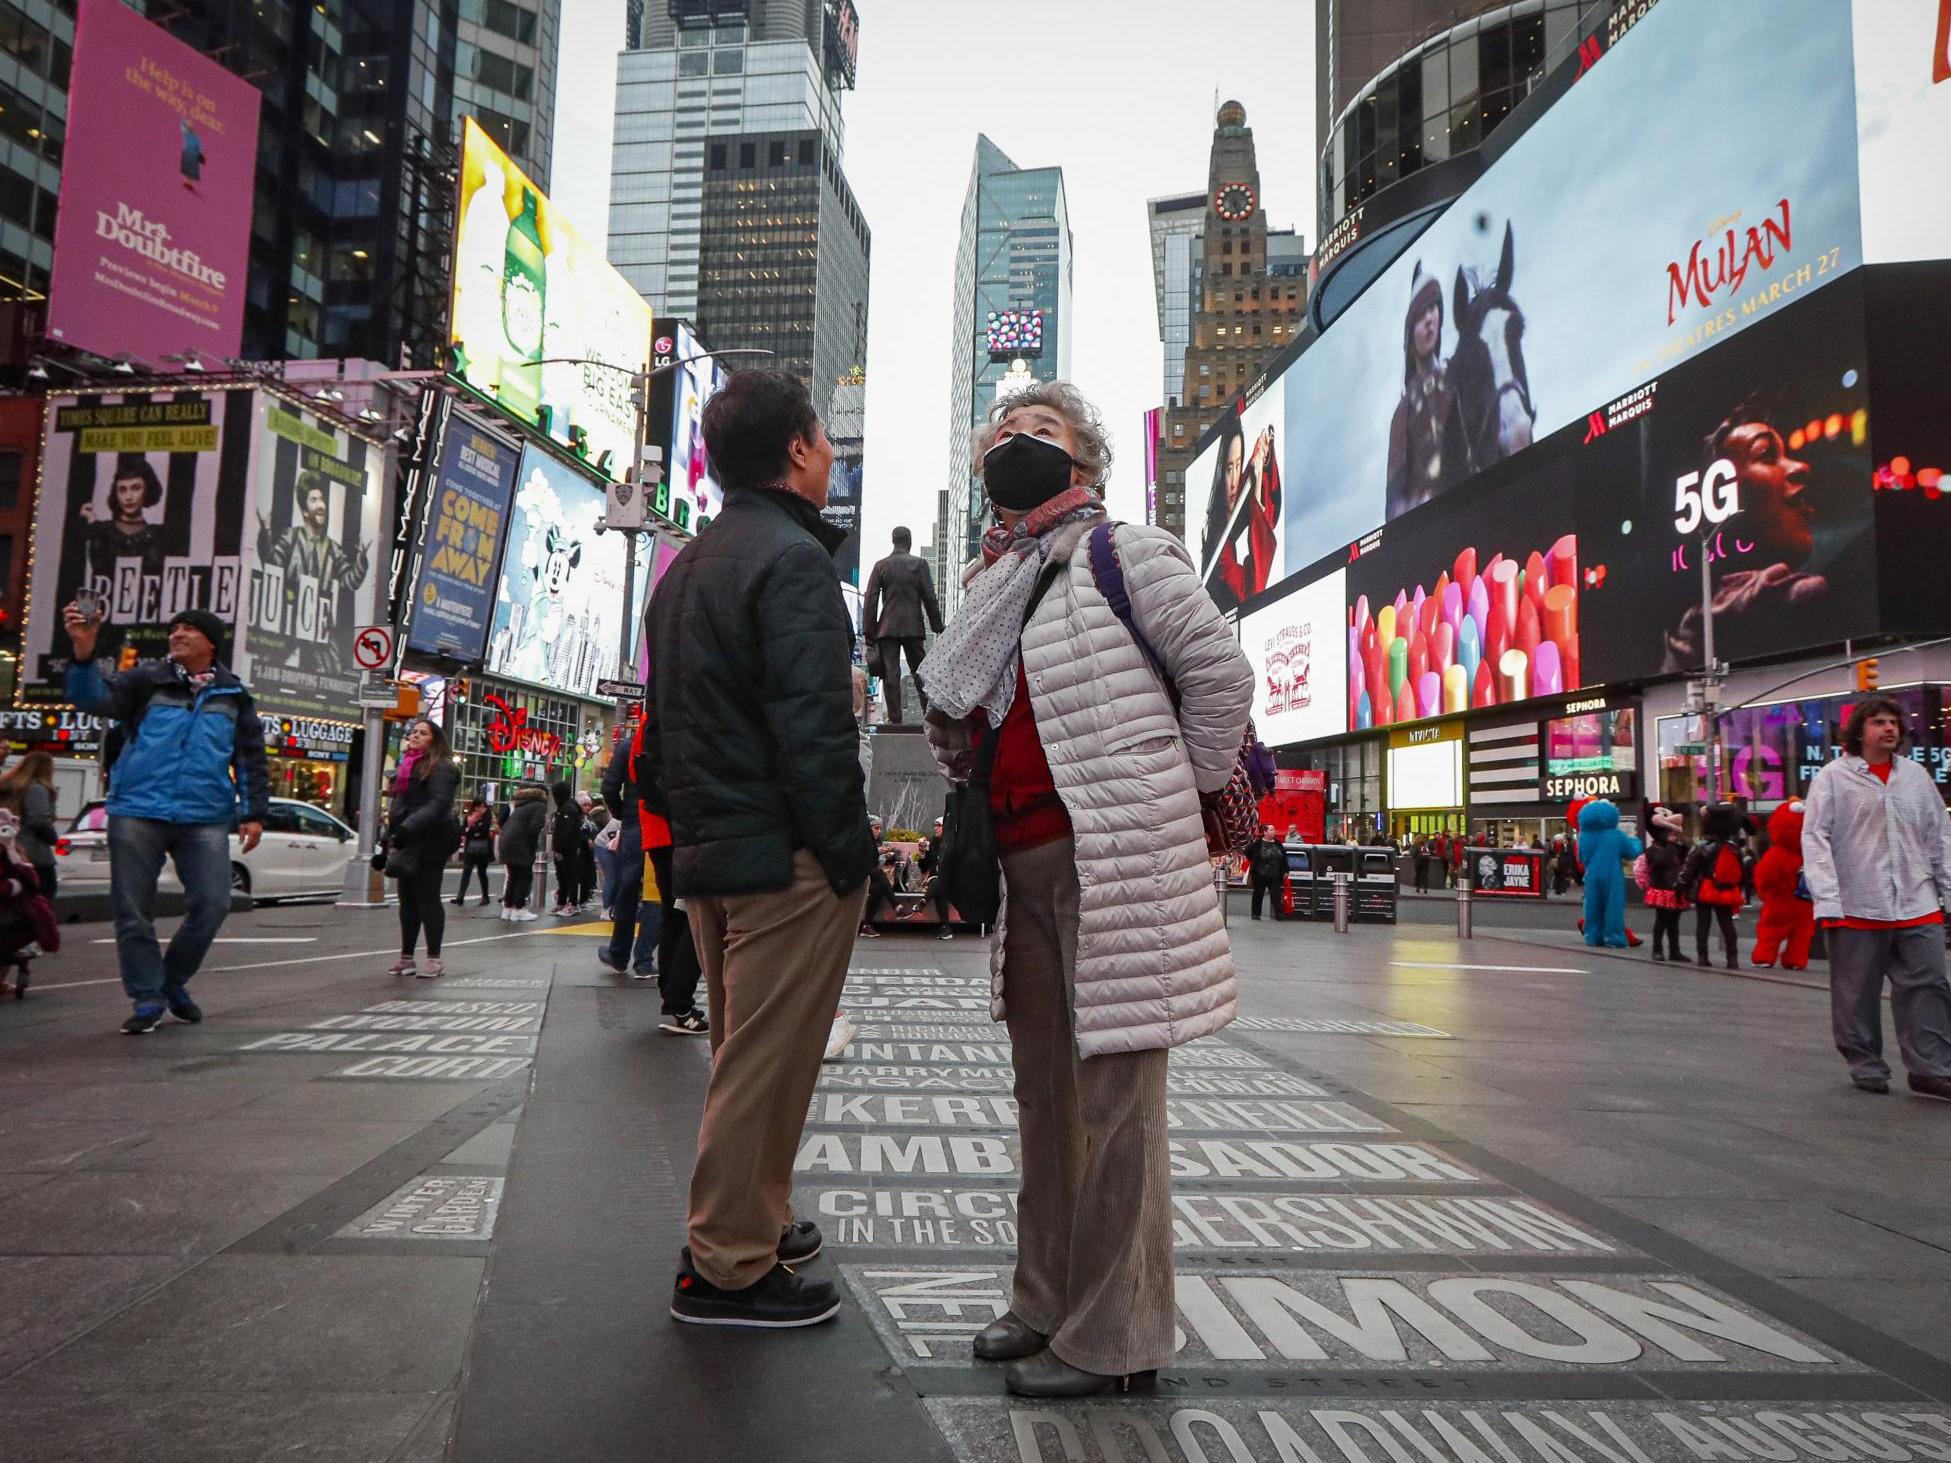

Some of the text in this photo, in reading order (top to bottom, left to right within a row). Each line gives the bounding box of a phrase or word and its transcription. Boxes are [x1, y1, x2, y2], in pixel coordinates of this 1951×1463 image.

[196, 94, 215, 113] on
[116, 201, 172, 240] Mrs.
[1319, 206, 1365, 256] MARRIOTT
[95, 210, 226, 290] Doubtfire
[1741, 263, 1812, 316] MARCH
[1817, 246, 1842, 276] 27
[654, 356, 671, 367] LG
[140, 403, 163, 422] CAN
[1608, 381, 1658, 415] MARRIOTT
[1608, 398, 1652, 428] MARQUIS
[85, 430, 118, 448] MAKE
[147, 429, 176, 447] FEEL
[1674, 458, 1740, 535] 5G
[441, 489, 500, 537] COME
[430, 544, 492, 586] AWAY
[94, 562, 238, 623] BEETLE
[249, 563, 331, 643] JUICE
[603, 684, 639, 696] ONE WAY
[1566, 698, 1606, 714] SEPHORA
[291, 720, 354, 744] LUGGAGE
[307, 751, 331, 759] SONY
[1546, 776, 1621, 797] SEPHORA
[1503, 864, 1530, 876] ERIKA
[1503, 875, 1530, 887] JAYNE
[240, 1033, 530, 1053] PALACE
[341, 1056, 534, 1079] CORT
[361, 1179, 457, 1233] WINTER
[410, 1179, 489, 1234] GARDEN
[818, 1190, 1019, 1219] CIRC
[837, 1218, 874, 1244] IN
[887, 1218, 961, 1245] THE
[863, 1271, 1010, 1358] NEIL
[1174, 1273, 1840, 1364] IMON
